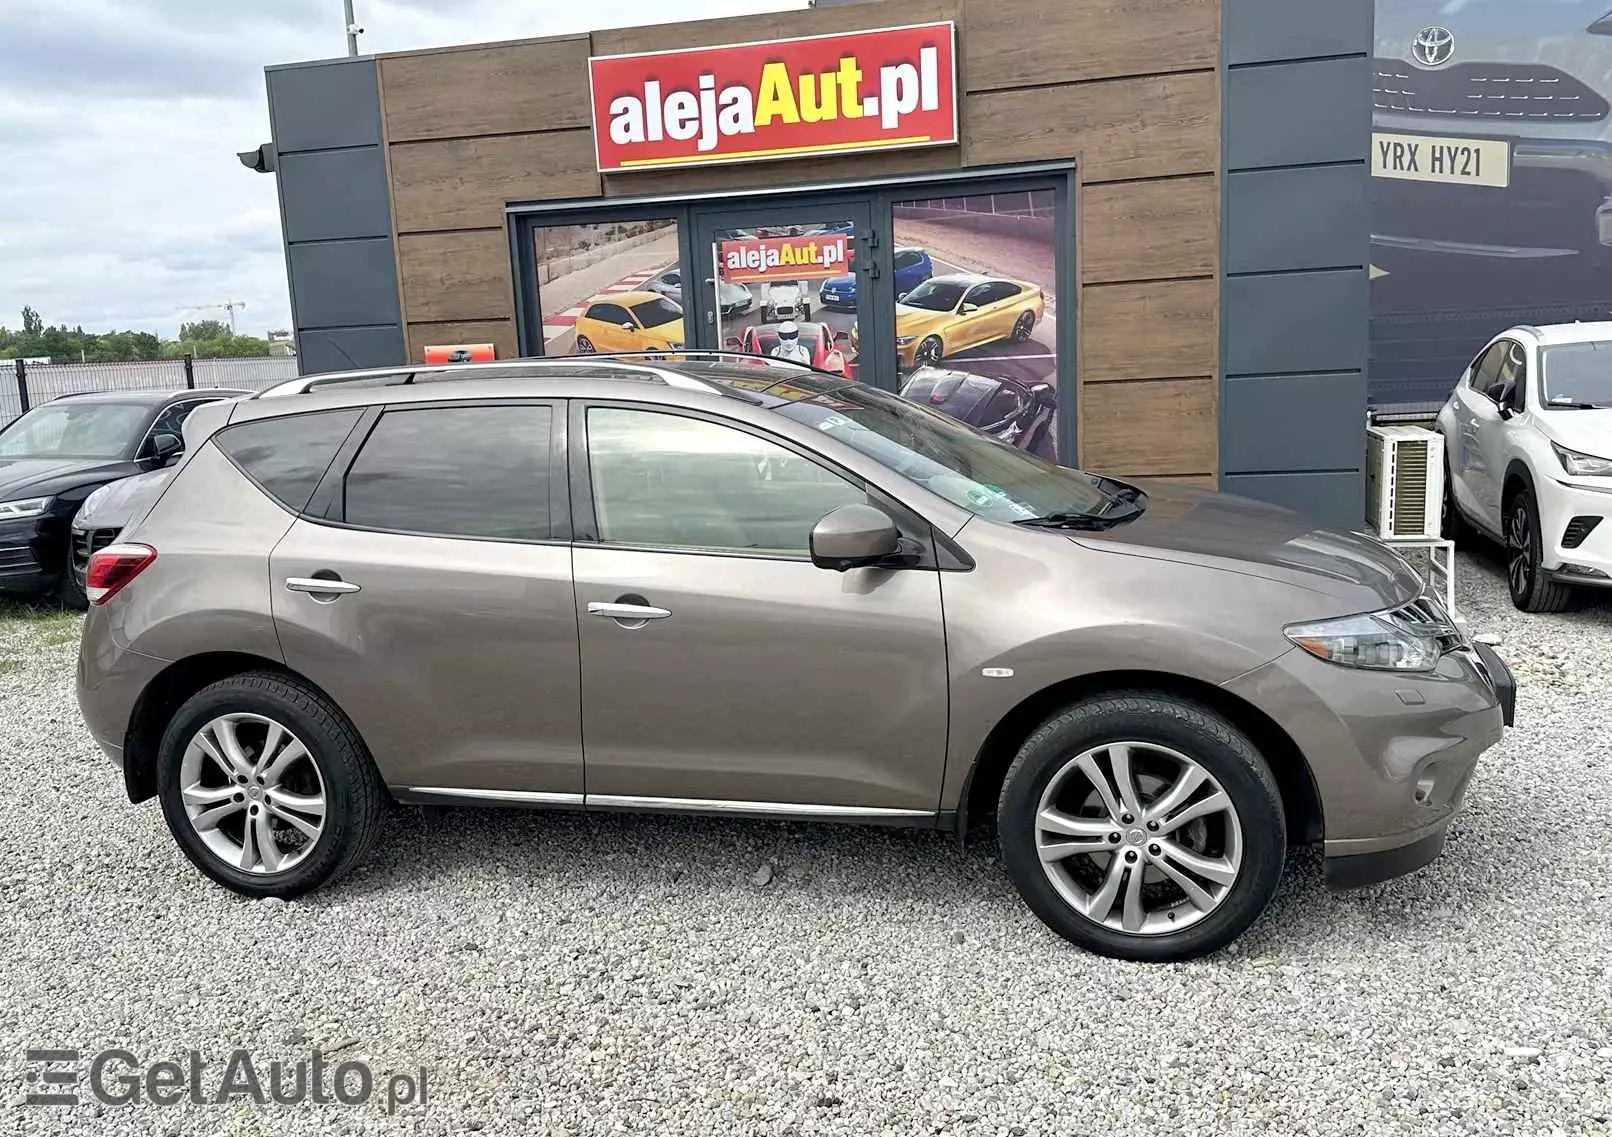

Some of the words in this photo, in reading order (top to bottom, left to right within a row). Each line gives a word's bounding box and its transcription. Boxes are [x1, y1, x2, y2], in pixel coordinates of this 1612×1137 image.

[609, 46, 939, 151] alejaAut.pl
[1379, 140, 1419, 172] YRX
[1431, 145, 1481, 177] HY21
[727, 239, 844, 272] alejaAut.pl
